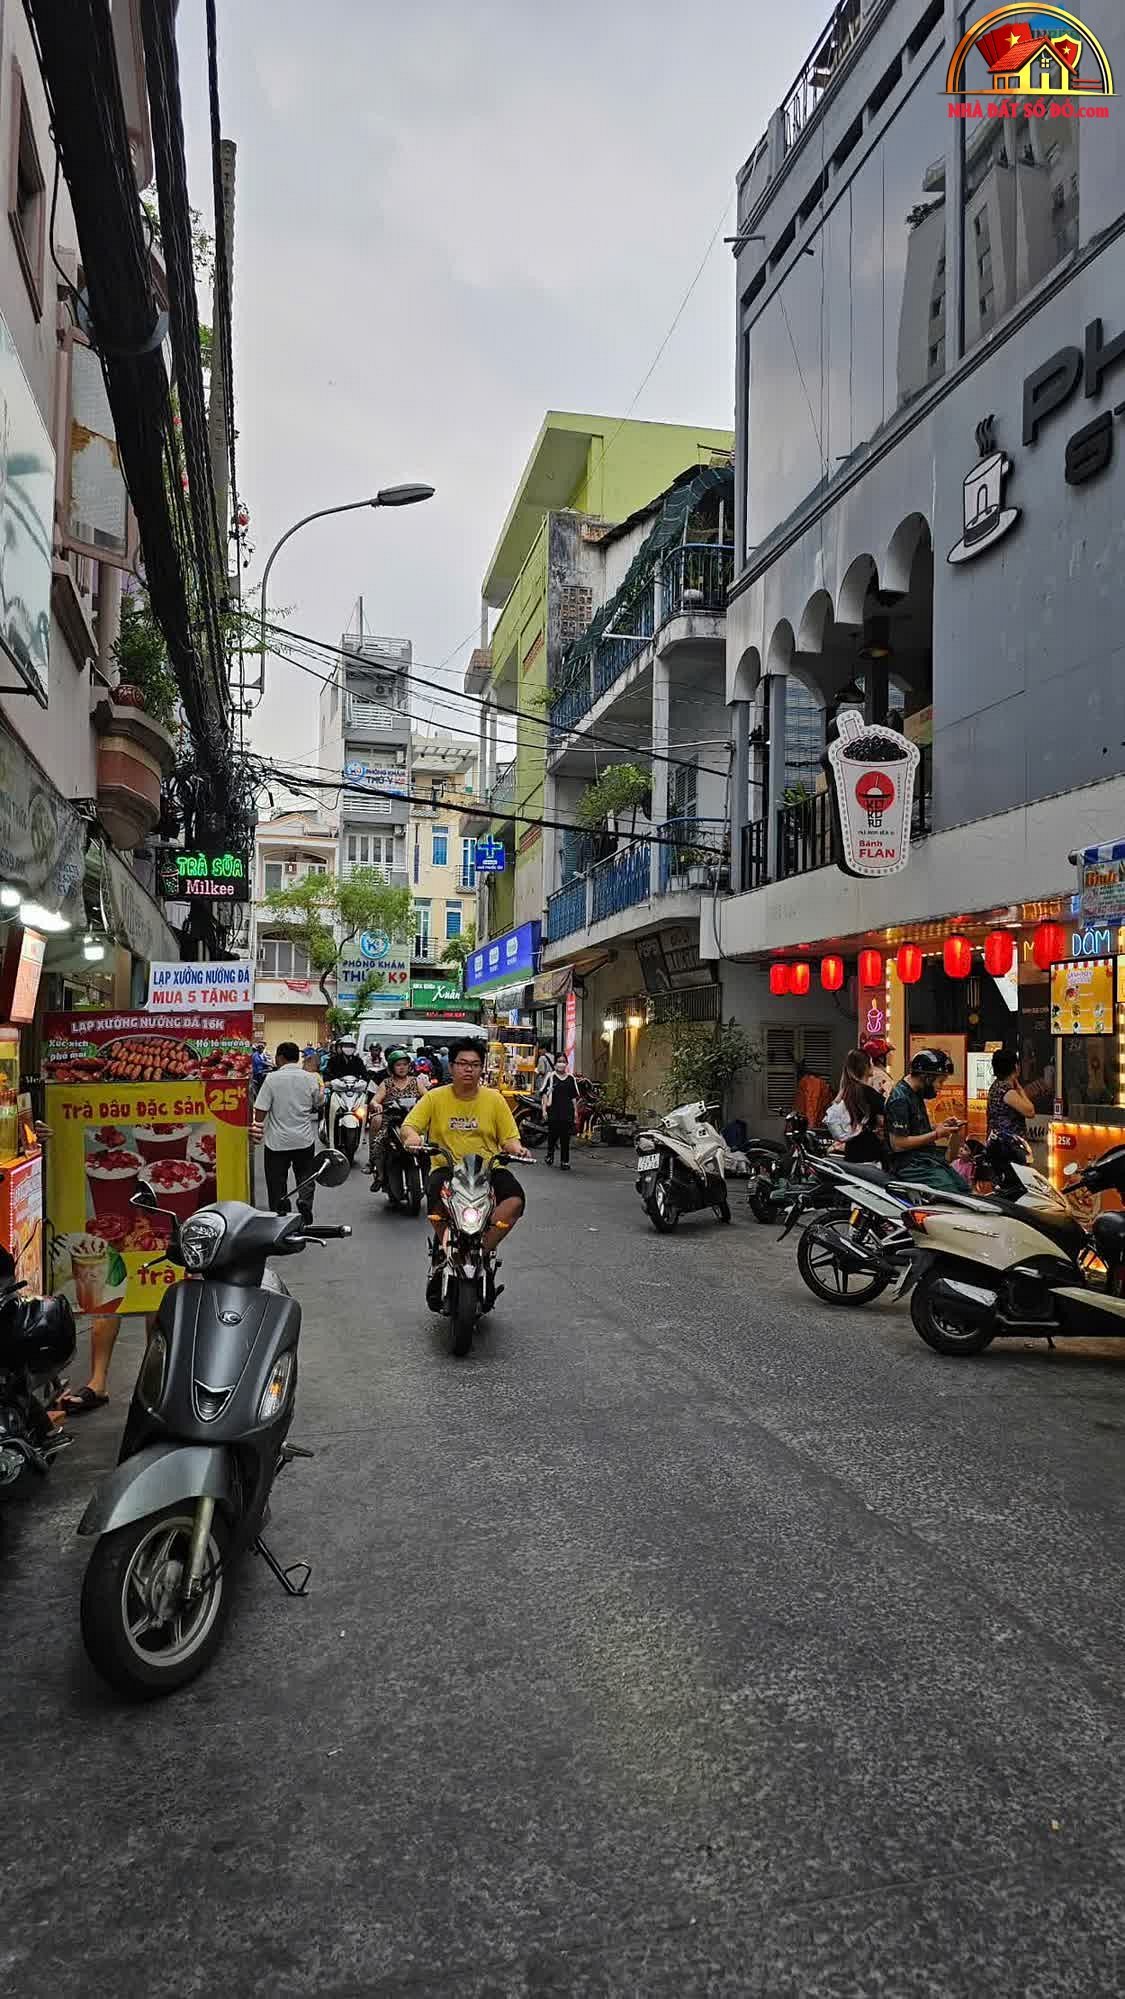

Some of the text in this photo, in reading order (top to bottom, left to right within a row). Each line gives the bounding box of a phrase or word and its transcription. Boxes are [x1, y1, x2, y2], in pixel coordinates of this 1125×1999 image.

[859, 849, 895, 858] FLAN
[176, 852, 243, 877] TRÀ SỮA
[185, 879, 234, 895] Milkee
[342, 959, 405, 969] PHÒNG KHÁM
[206, 966, 236, 984] NƯỚNG
[238, 966, 250, 983] ĐÁ
[388, 971, 407, 984] K9
[153, 988, 250, 1007] MUA 5 TẶNG 1
[432, 985, 460, 1001] Xuân
[62, 1100, 93, 1120] Trà
[99, 1099, 131, 1118] Dâu
[136, 1099, 168, 1120] Đặc
